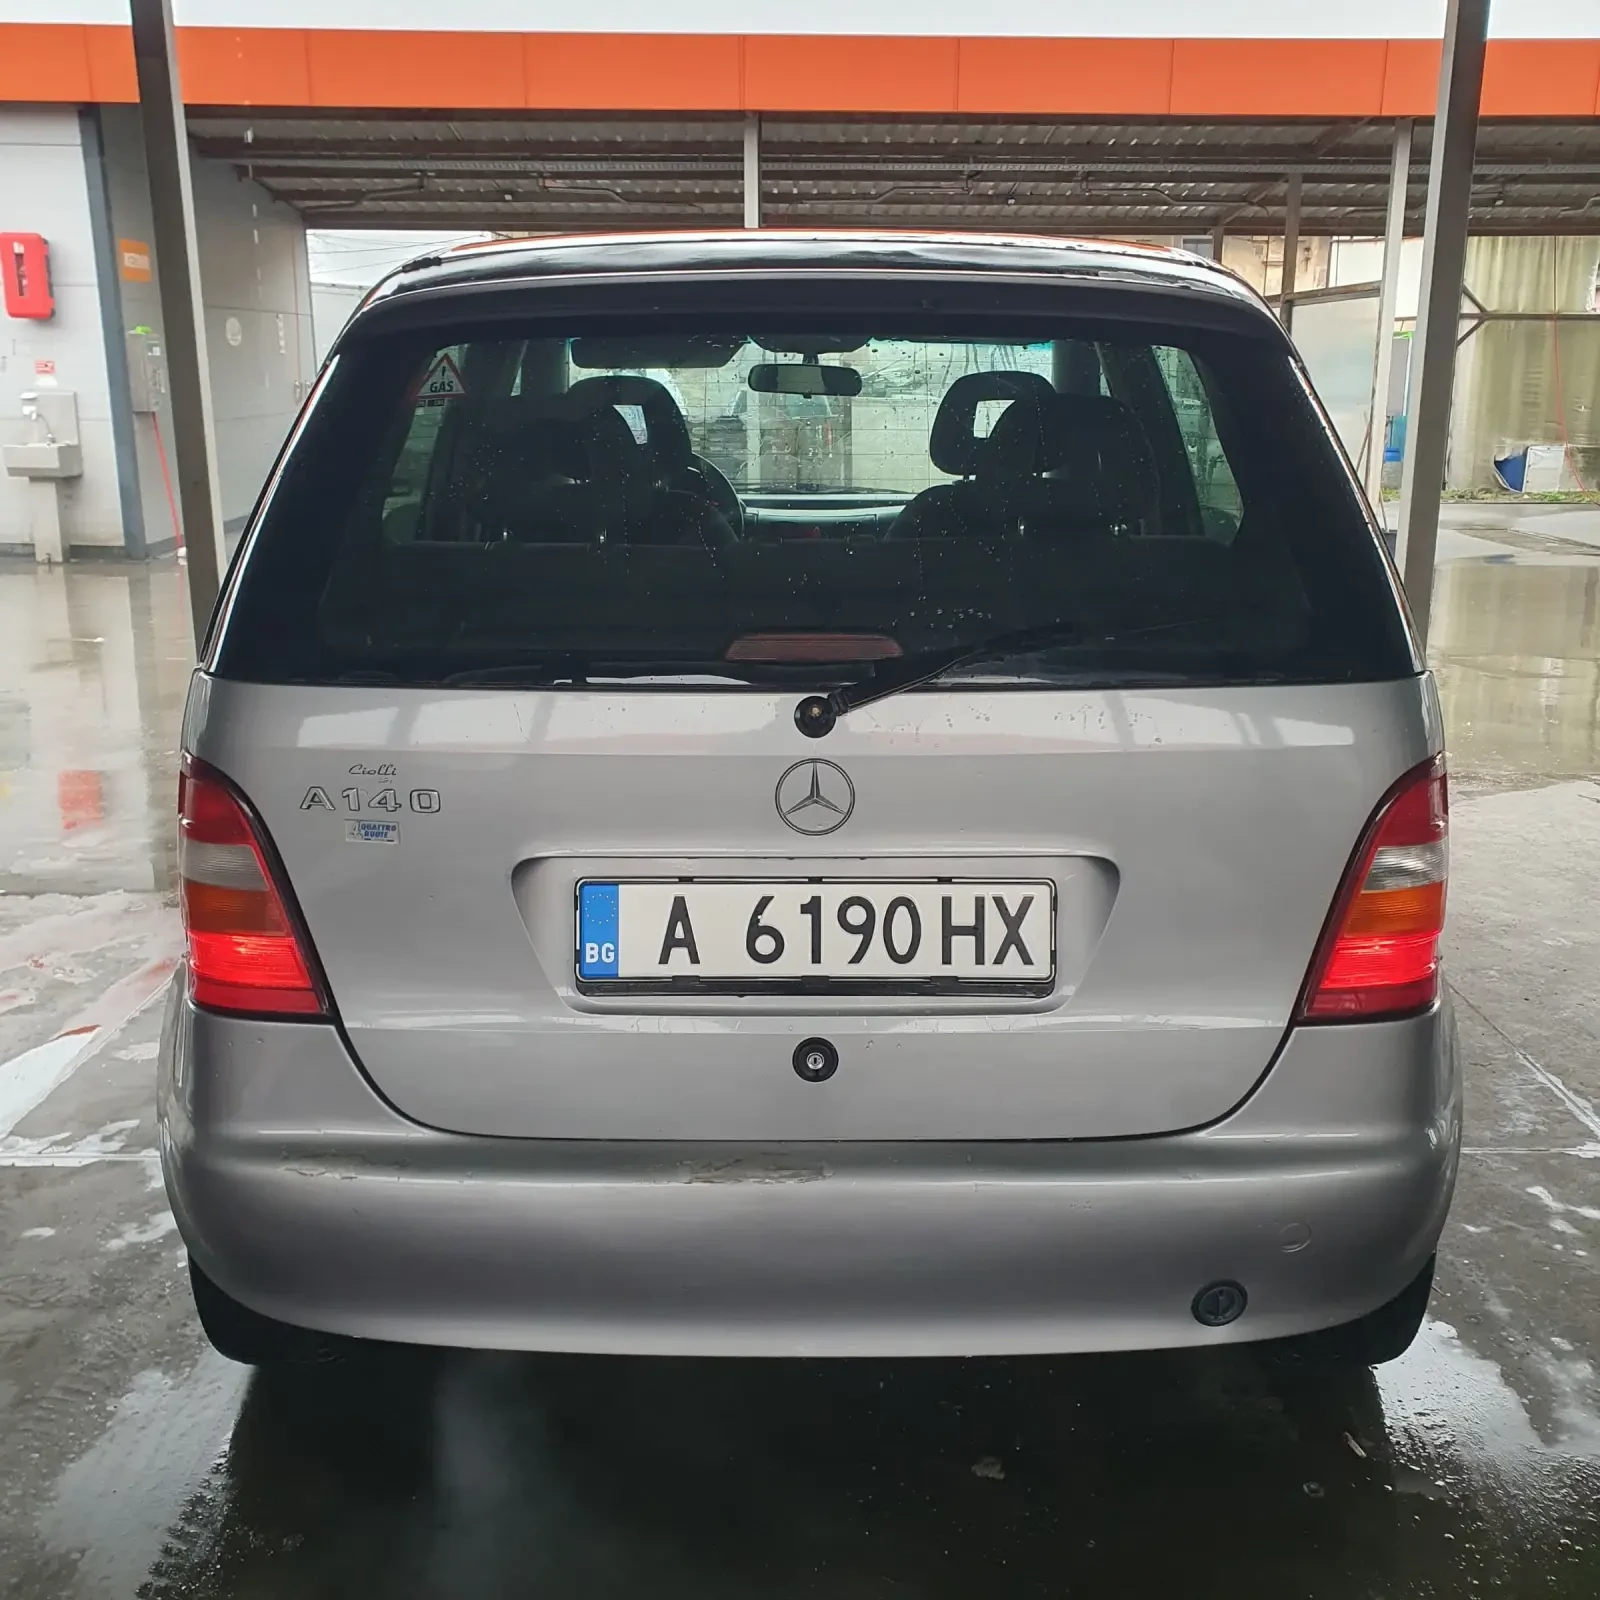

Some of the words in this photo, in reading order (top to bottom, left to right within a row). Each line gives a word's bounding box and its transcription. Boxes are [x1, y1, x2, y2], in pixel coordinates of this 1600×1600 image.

[429, 380, 454, 393] GAS
[299, 786, 441, 814] A140
[361, 823, 397, 832] QUATTRO
[657, 895, 701, 965] A
[584, 942, 615, 964] BG
